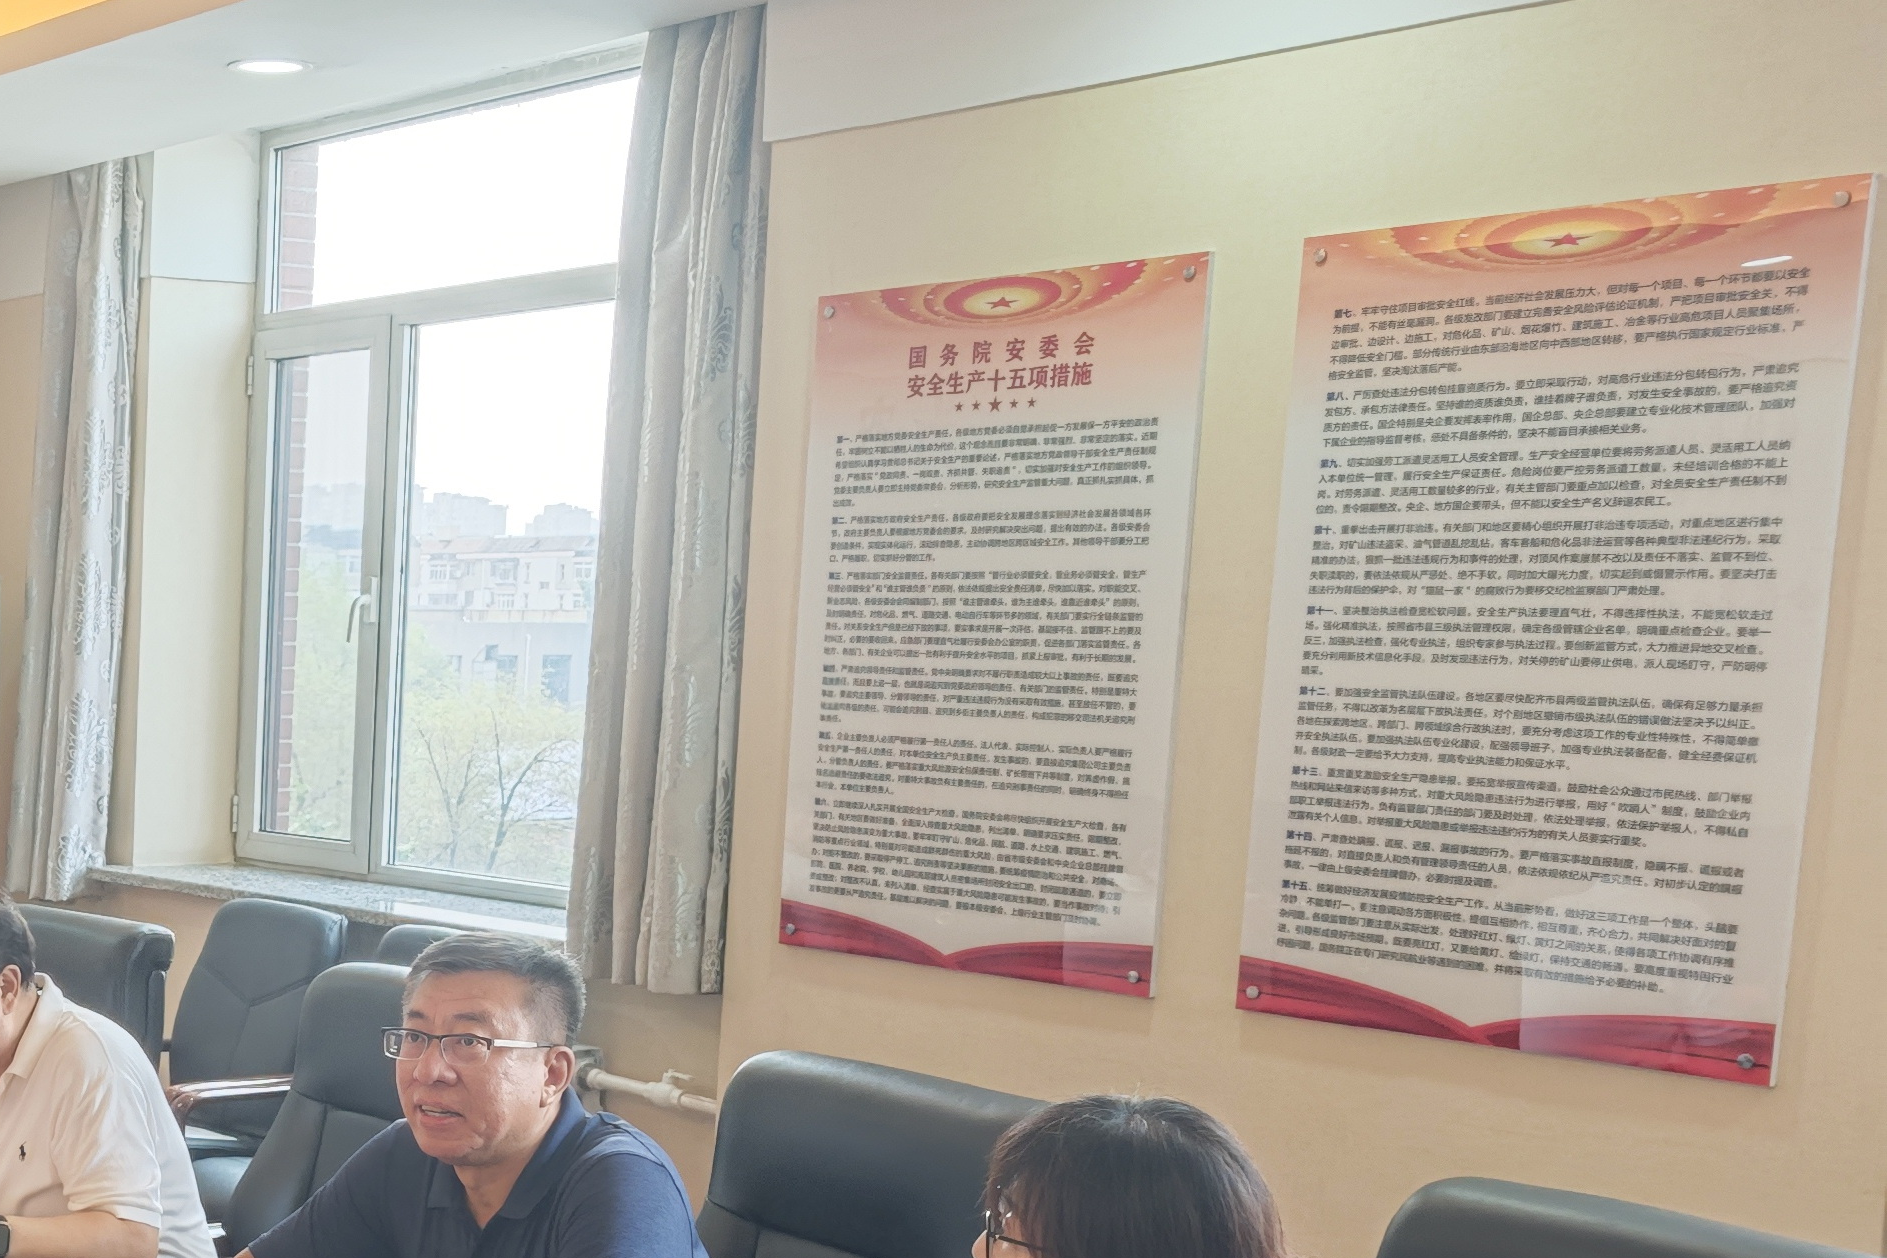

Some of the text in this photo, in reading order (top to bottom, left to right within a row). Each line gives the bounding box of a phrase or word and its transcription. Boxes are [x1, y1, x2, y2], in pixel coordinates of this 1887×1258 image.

[908, 331, 1095, 369] 国务院安委会
[906, 361, 1093, 399] 安全生产十五项措施
